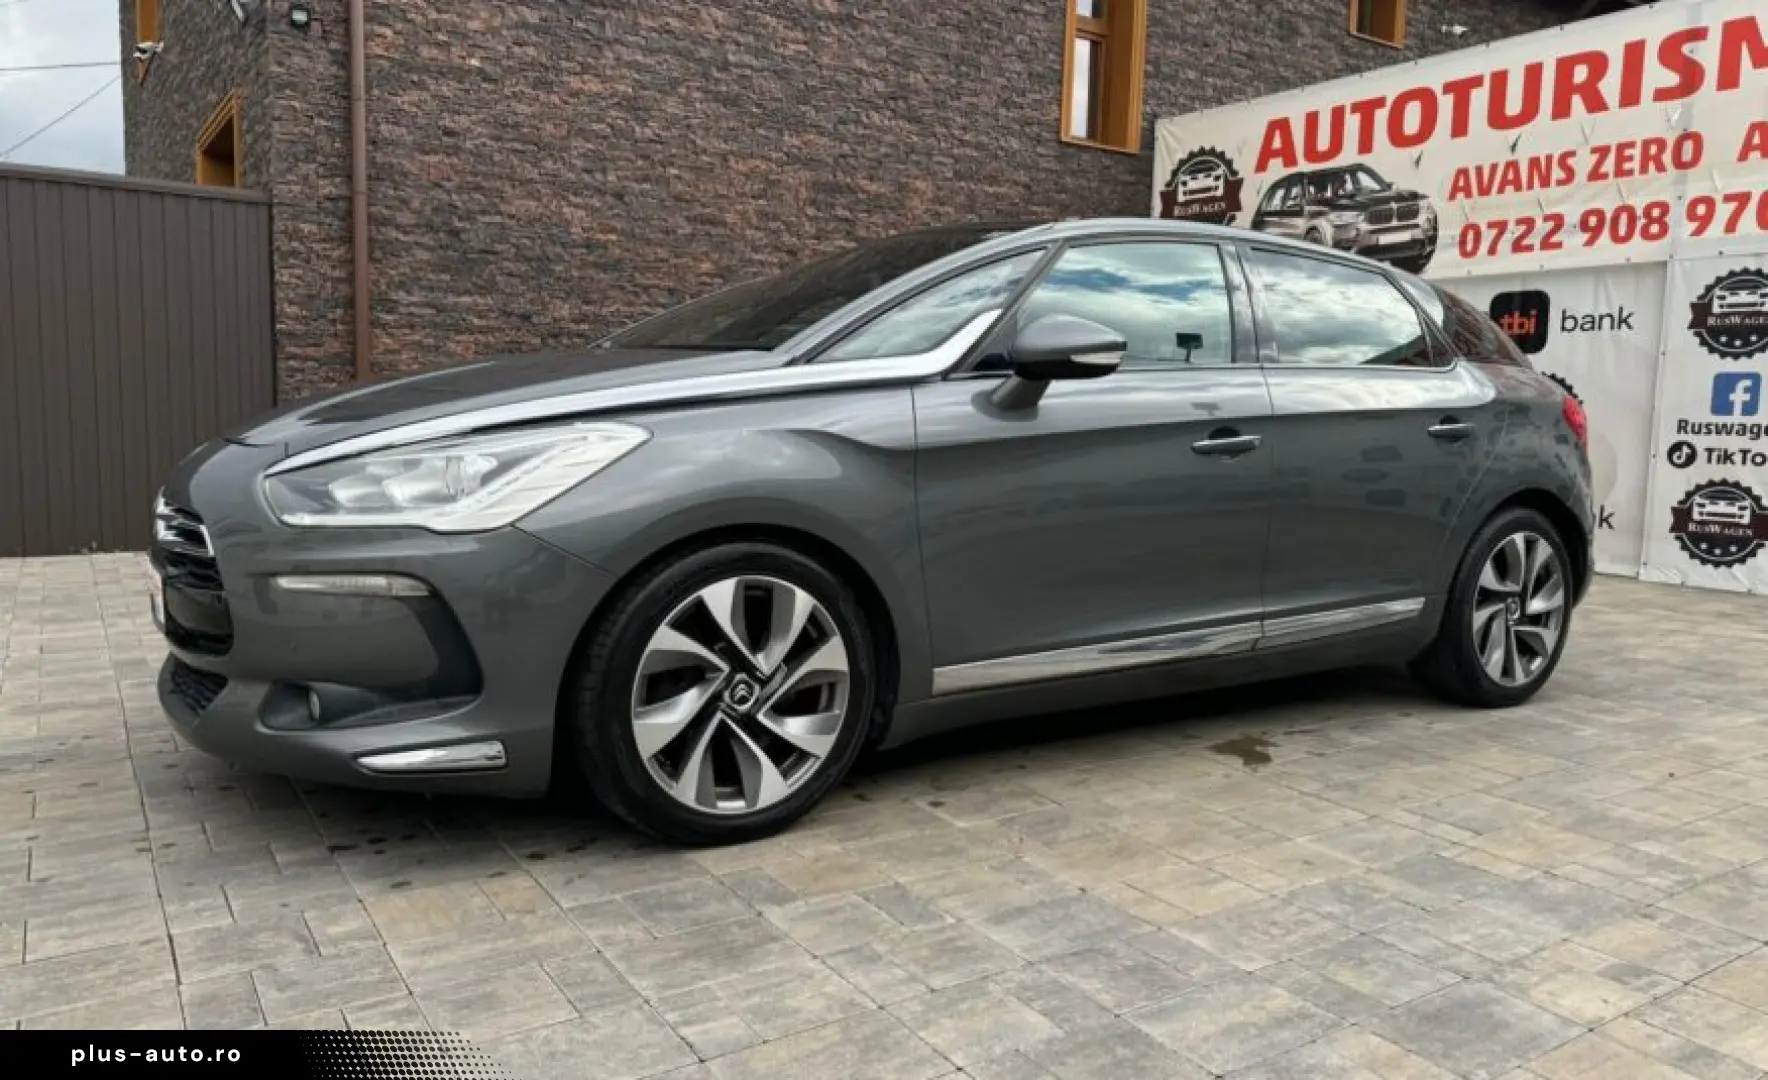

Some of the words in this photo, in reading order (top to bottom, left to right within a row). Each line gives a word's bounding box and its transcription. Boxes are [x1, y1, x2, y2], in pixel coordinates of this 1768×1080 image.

[1447, 150, 1577, 202] AVANS
[1587, 131, 1704, 182] ZERO
[1458, 213, 1565, 259] 0722
[1579, 200, 1670, 247] 908
[1501, 309, 1537, 335] tbi
[1561, 306, 1634, 333] bank
[1676, 419, 1768, 440] Ruswag
